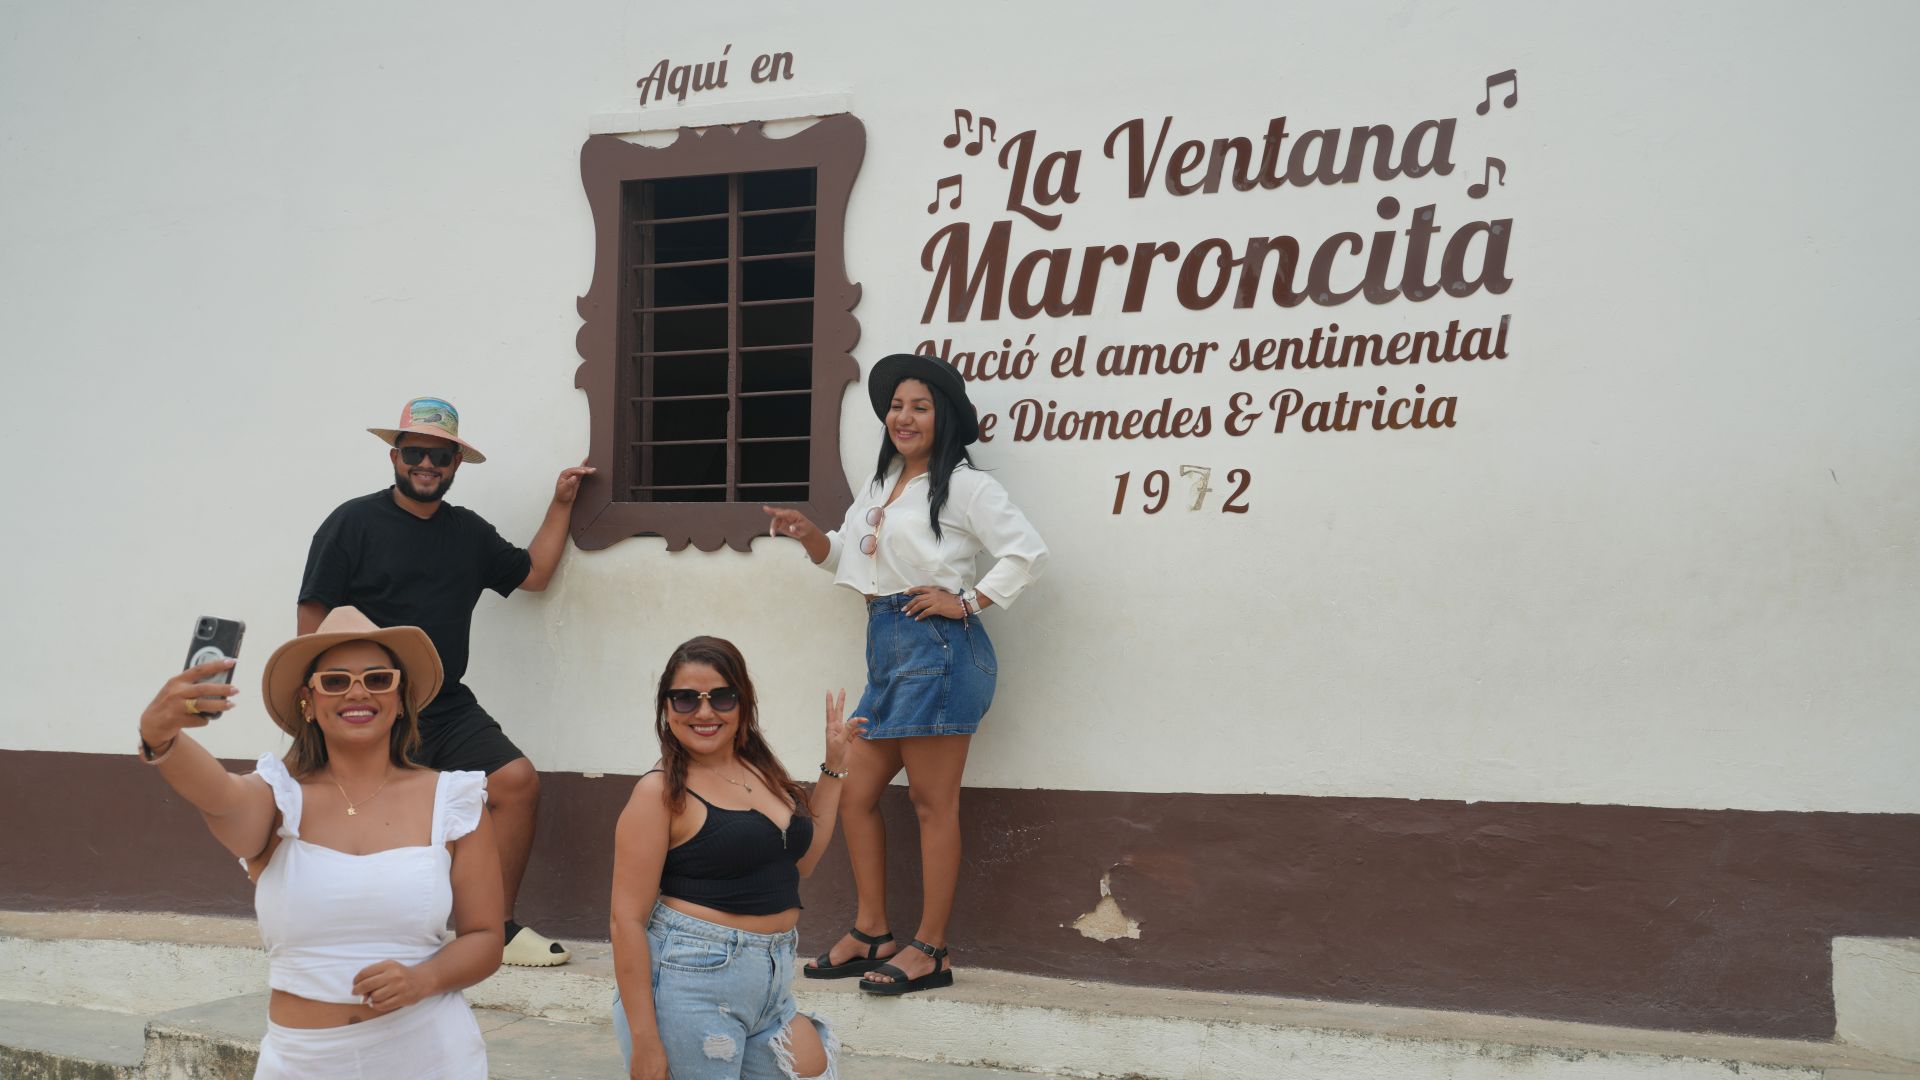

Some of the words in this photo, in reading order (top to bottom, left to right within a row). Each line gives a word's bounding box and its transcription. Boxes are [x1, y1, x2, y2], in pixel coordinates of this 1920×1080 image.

[637, 43, 732, 106] Aquí
[750, 50, 794, 83] en
[998, 130, 1082, 231] La
[1104, 116, 1457, 198] Ventana
[920, 196, 1514, 324] Marroncita
[1051, 335, 1087, 378] el
[1096, 341, 1219, 377] amor
[1229, 314, 1512, 372] sentimental
[971, 404, 998, 443] e
[1009, 398, 1212, 442] Diomedes
[1224, 392, 1264, 437] &
[1269, 384, 1458, 433] Patricia
[1112, 463, 1252, 515] 1972
